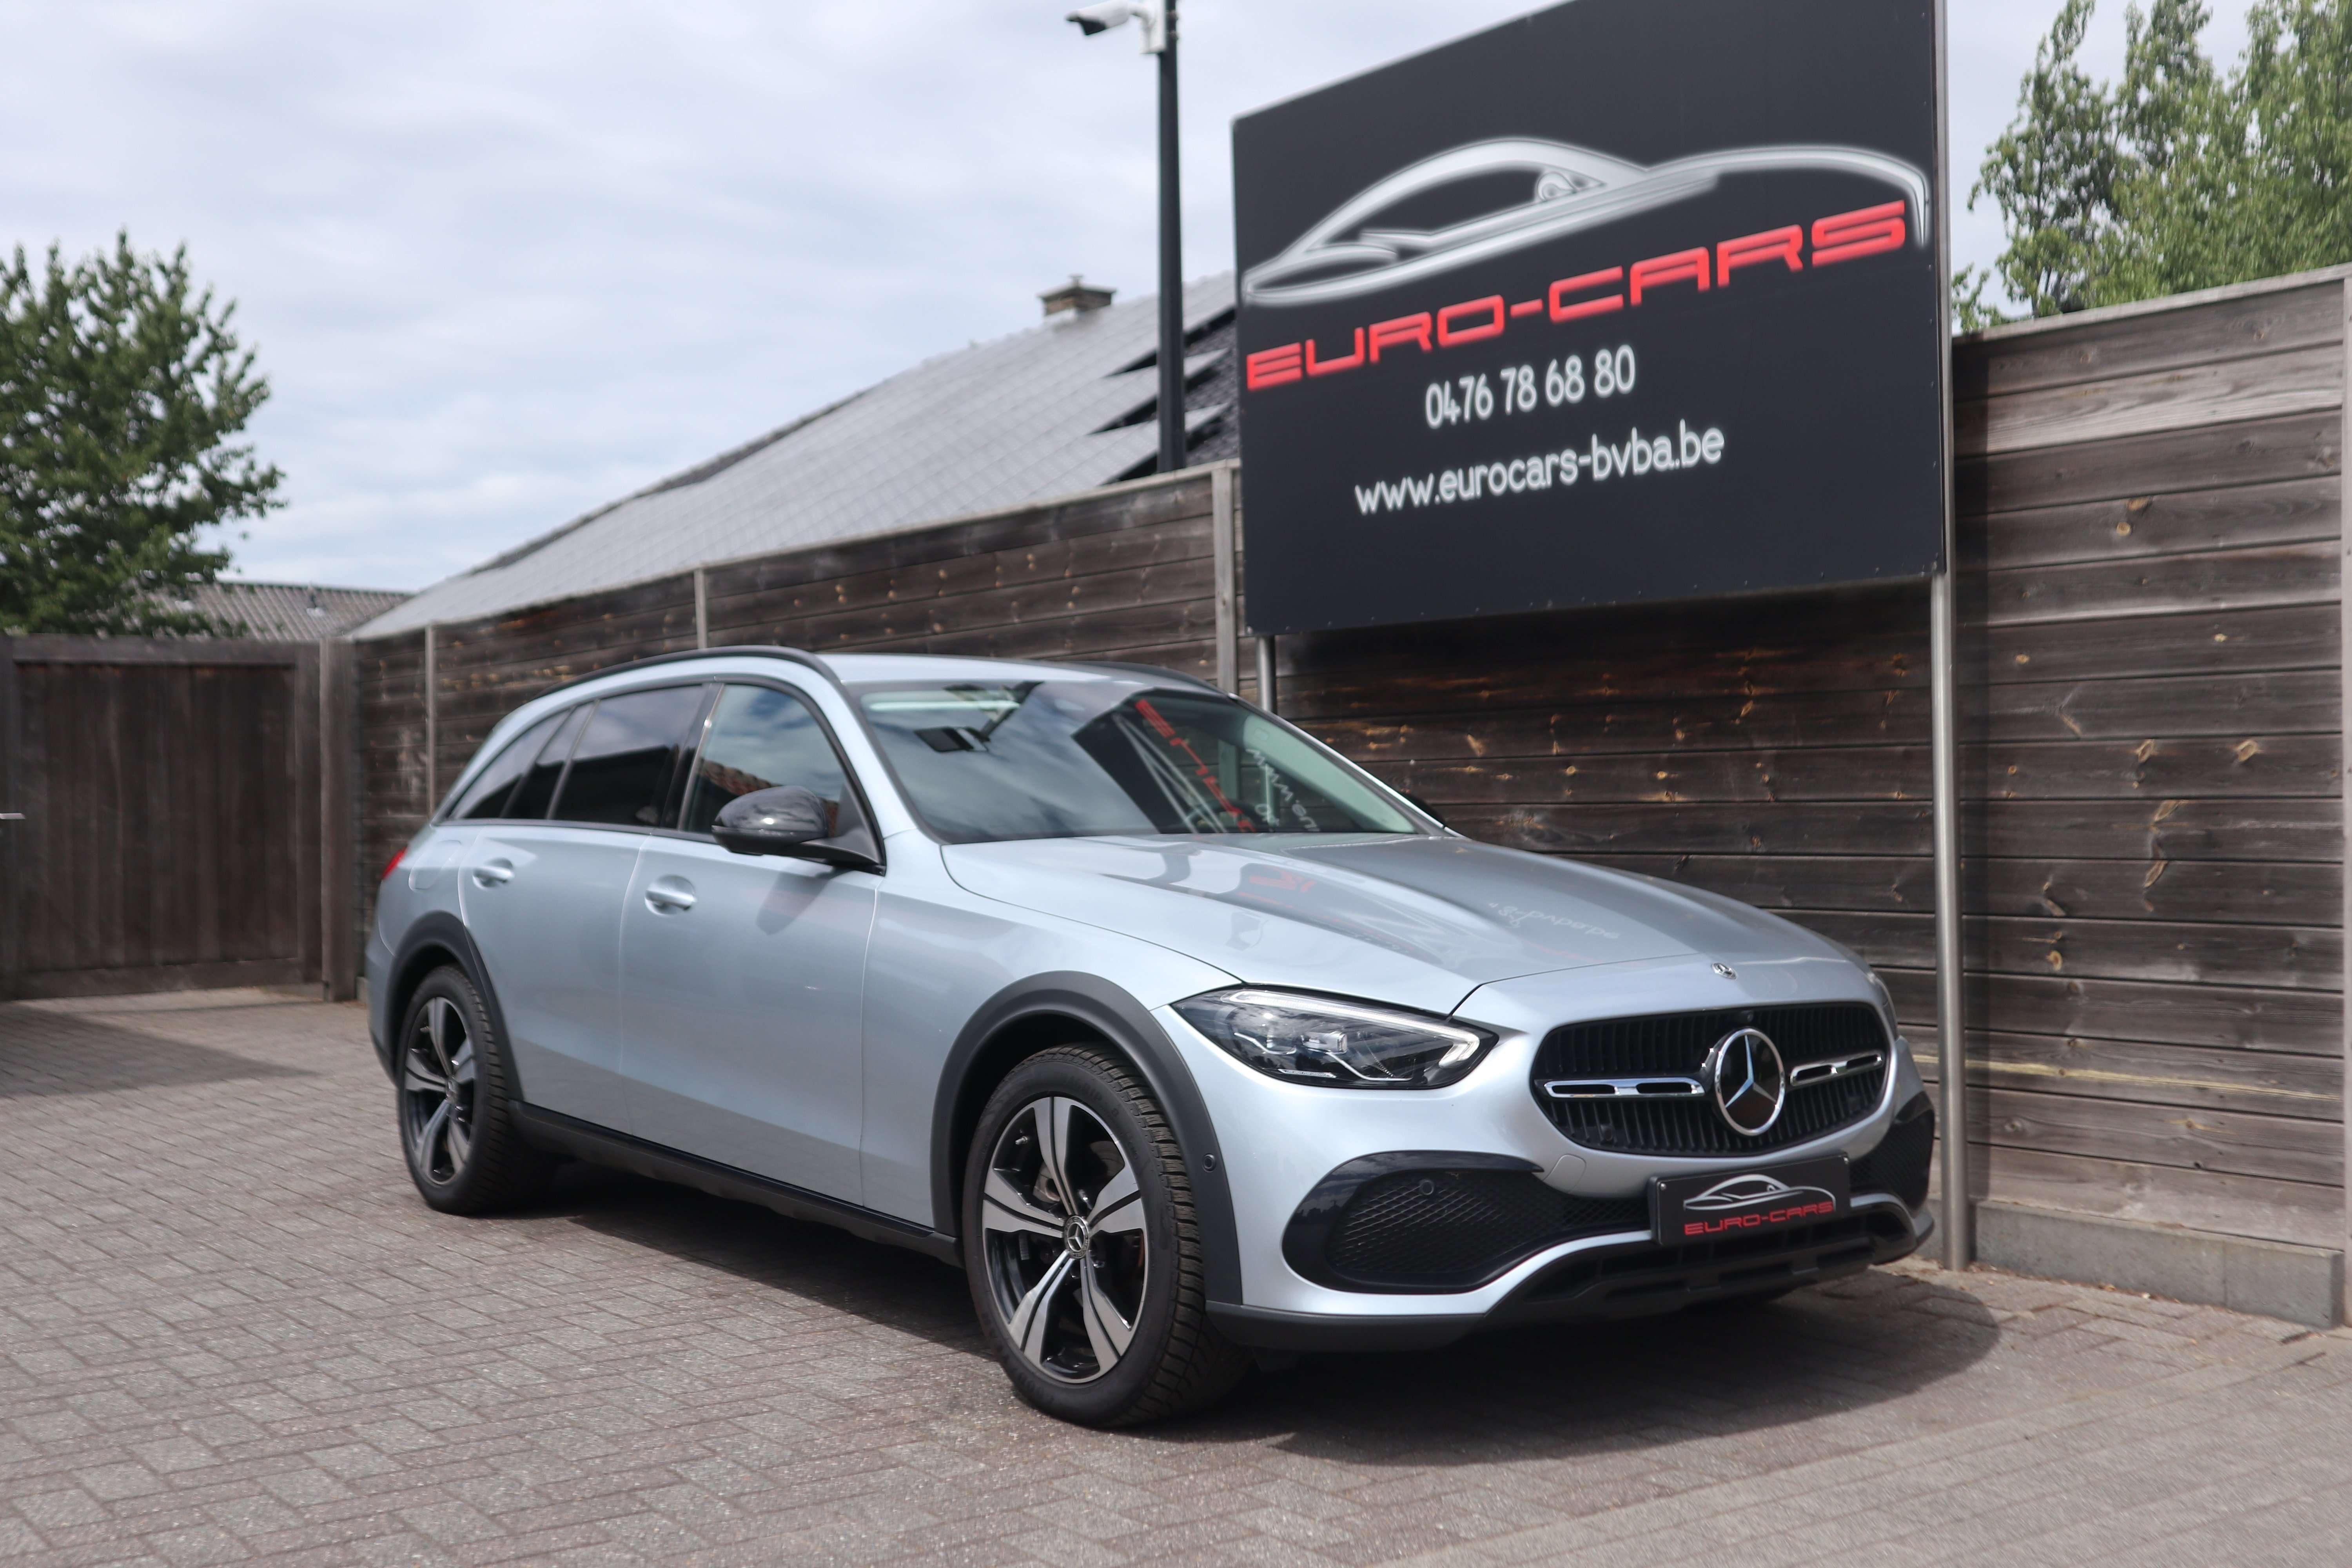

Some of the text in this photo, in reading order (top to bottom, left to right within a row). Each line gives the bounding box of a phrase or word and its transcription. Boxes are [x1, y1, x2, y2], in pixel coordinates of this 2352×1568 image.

[1247, 201, 1906, 390] EURO-CARS
[1425, 344, 1636, 428] 0476 78 68 80
[1354, 419, 1725, 514] www.eurocars-bvba.be
[1684, 1201, 1833, 1236] EURO-CARS
